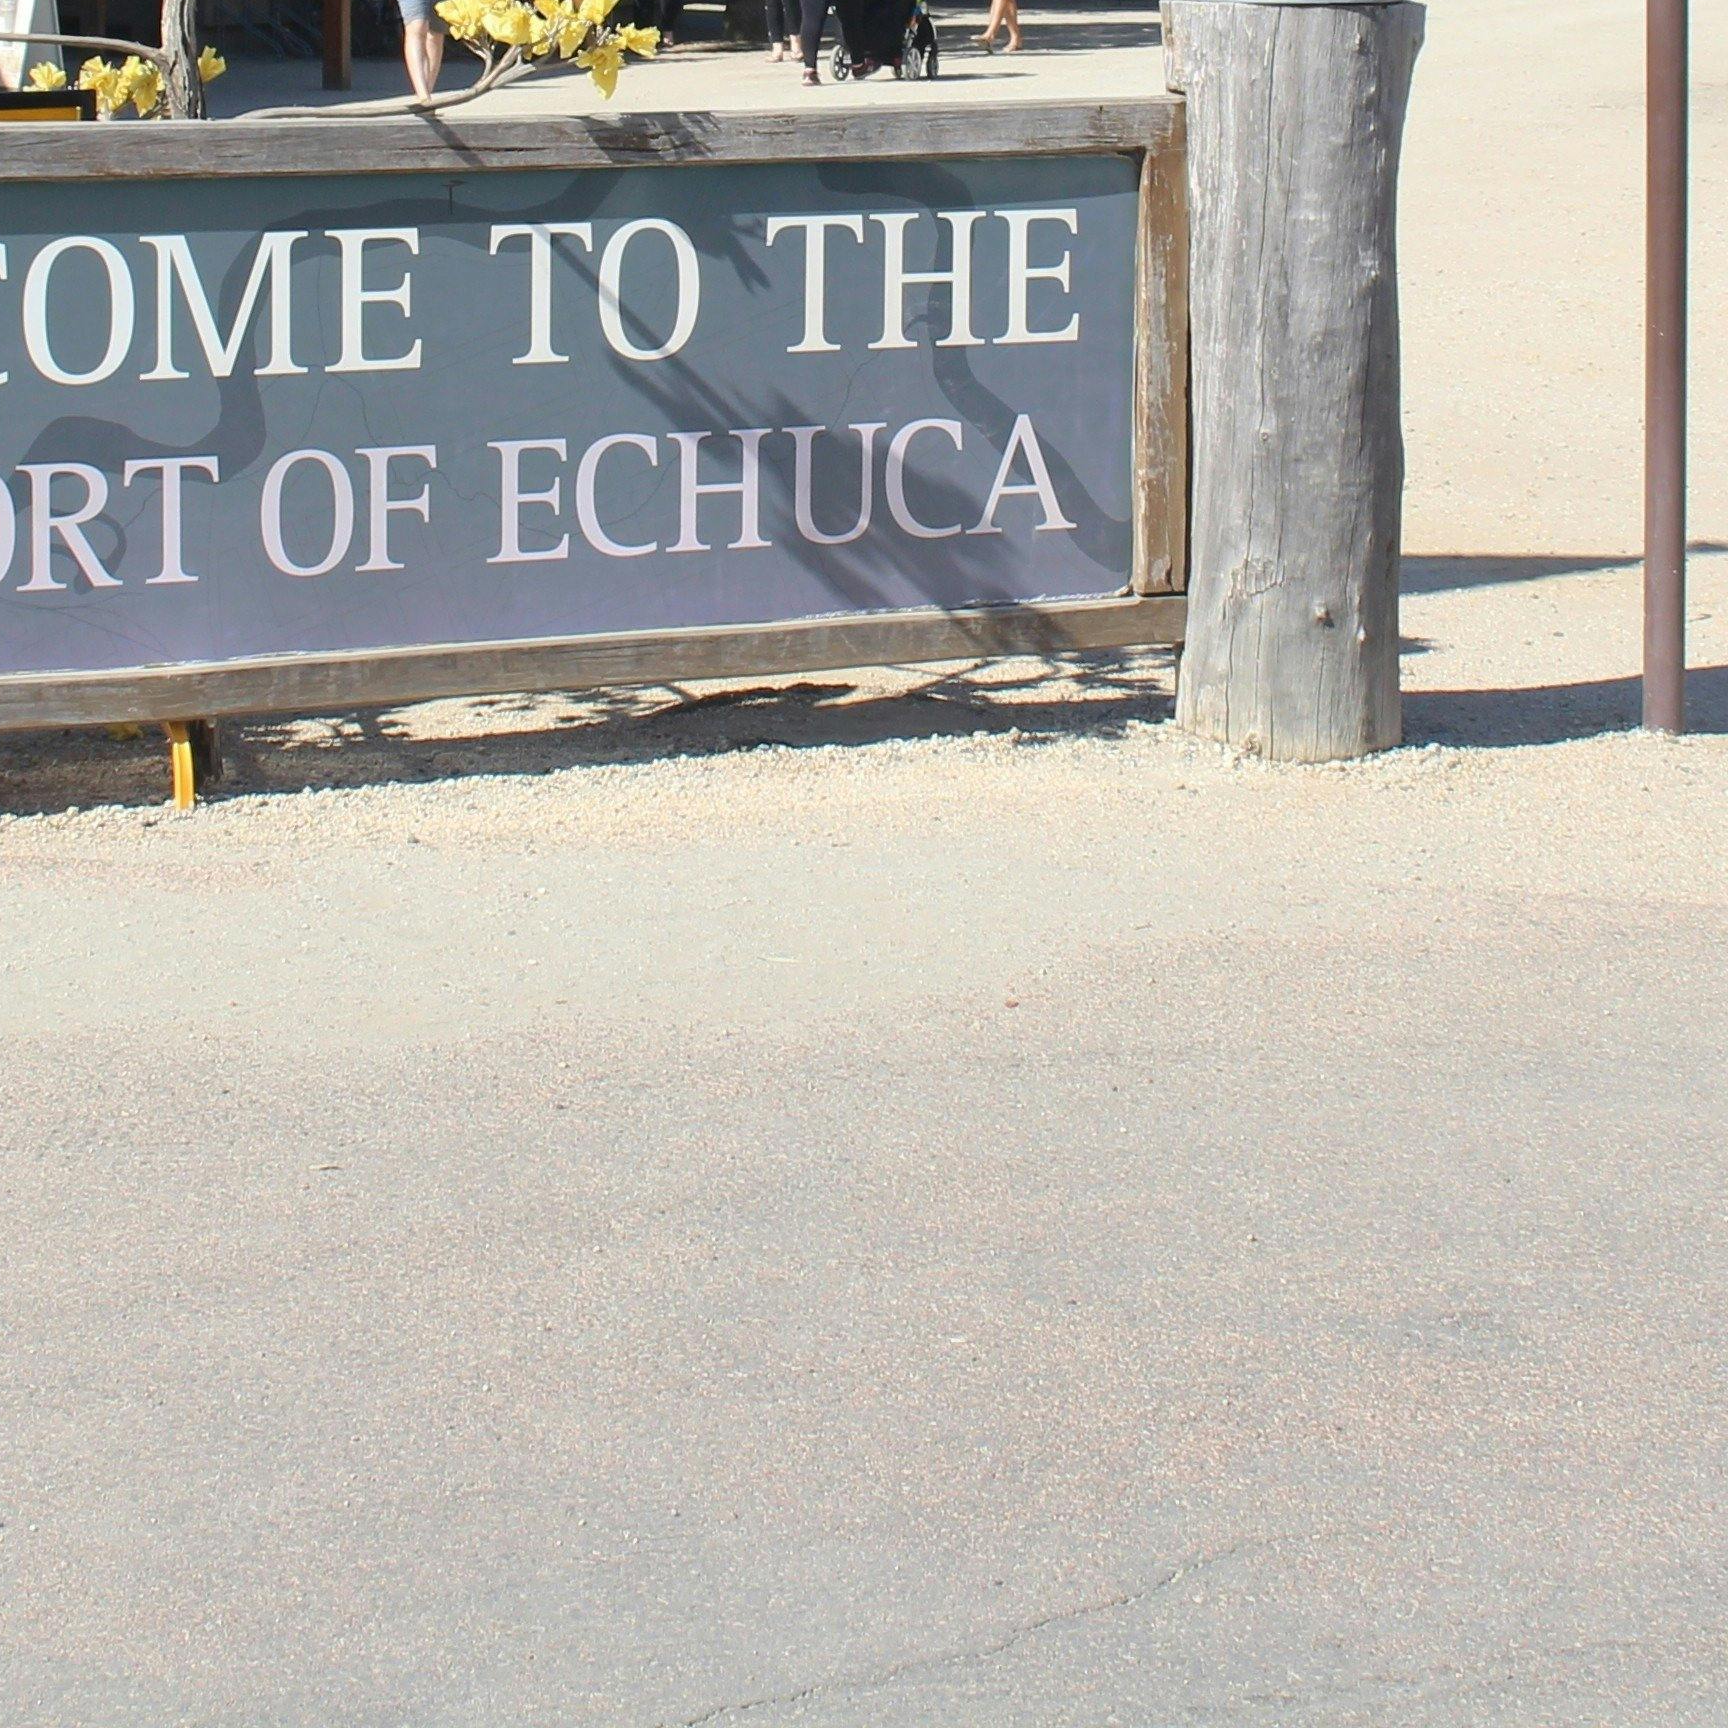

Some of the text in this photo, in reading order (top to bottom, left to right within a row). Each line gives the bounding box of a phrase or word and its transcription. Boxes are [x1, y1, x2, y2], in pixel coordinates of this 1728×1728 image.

[488, 217, 701, 365] TO
[765, 208, 1080, 354] THE
[259, 444, 438, 578] OF
[486, 413, 1077, 565] ECHUCA
